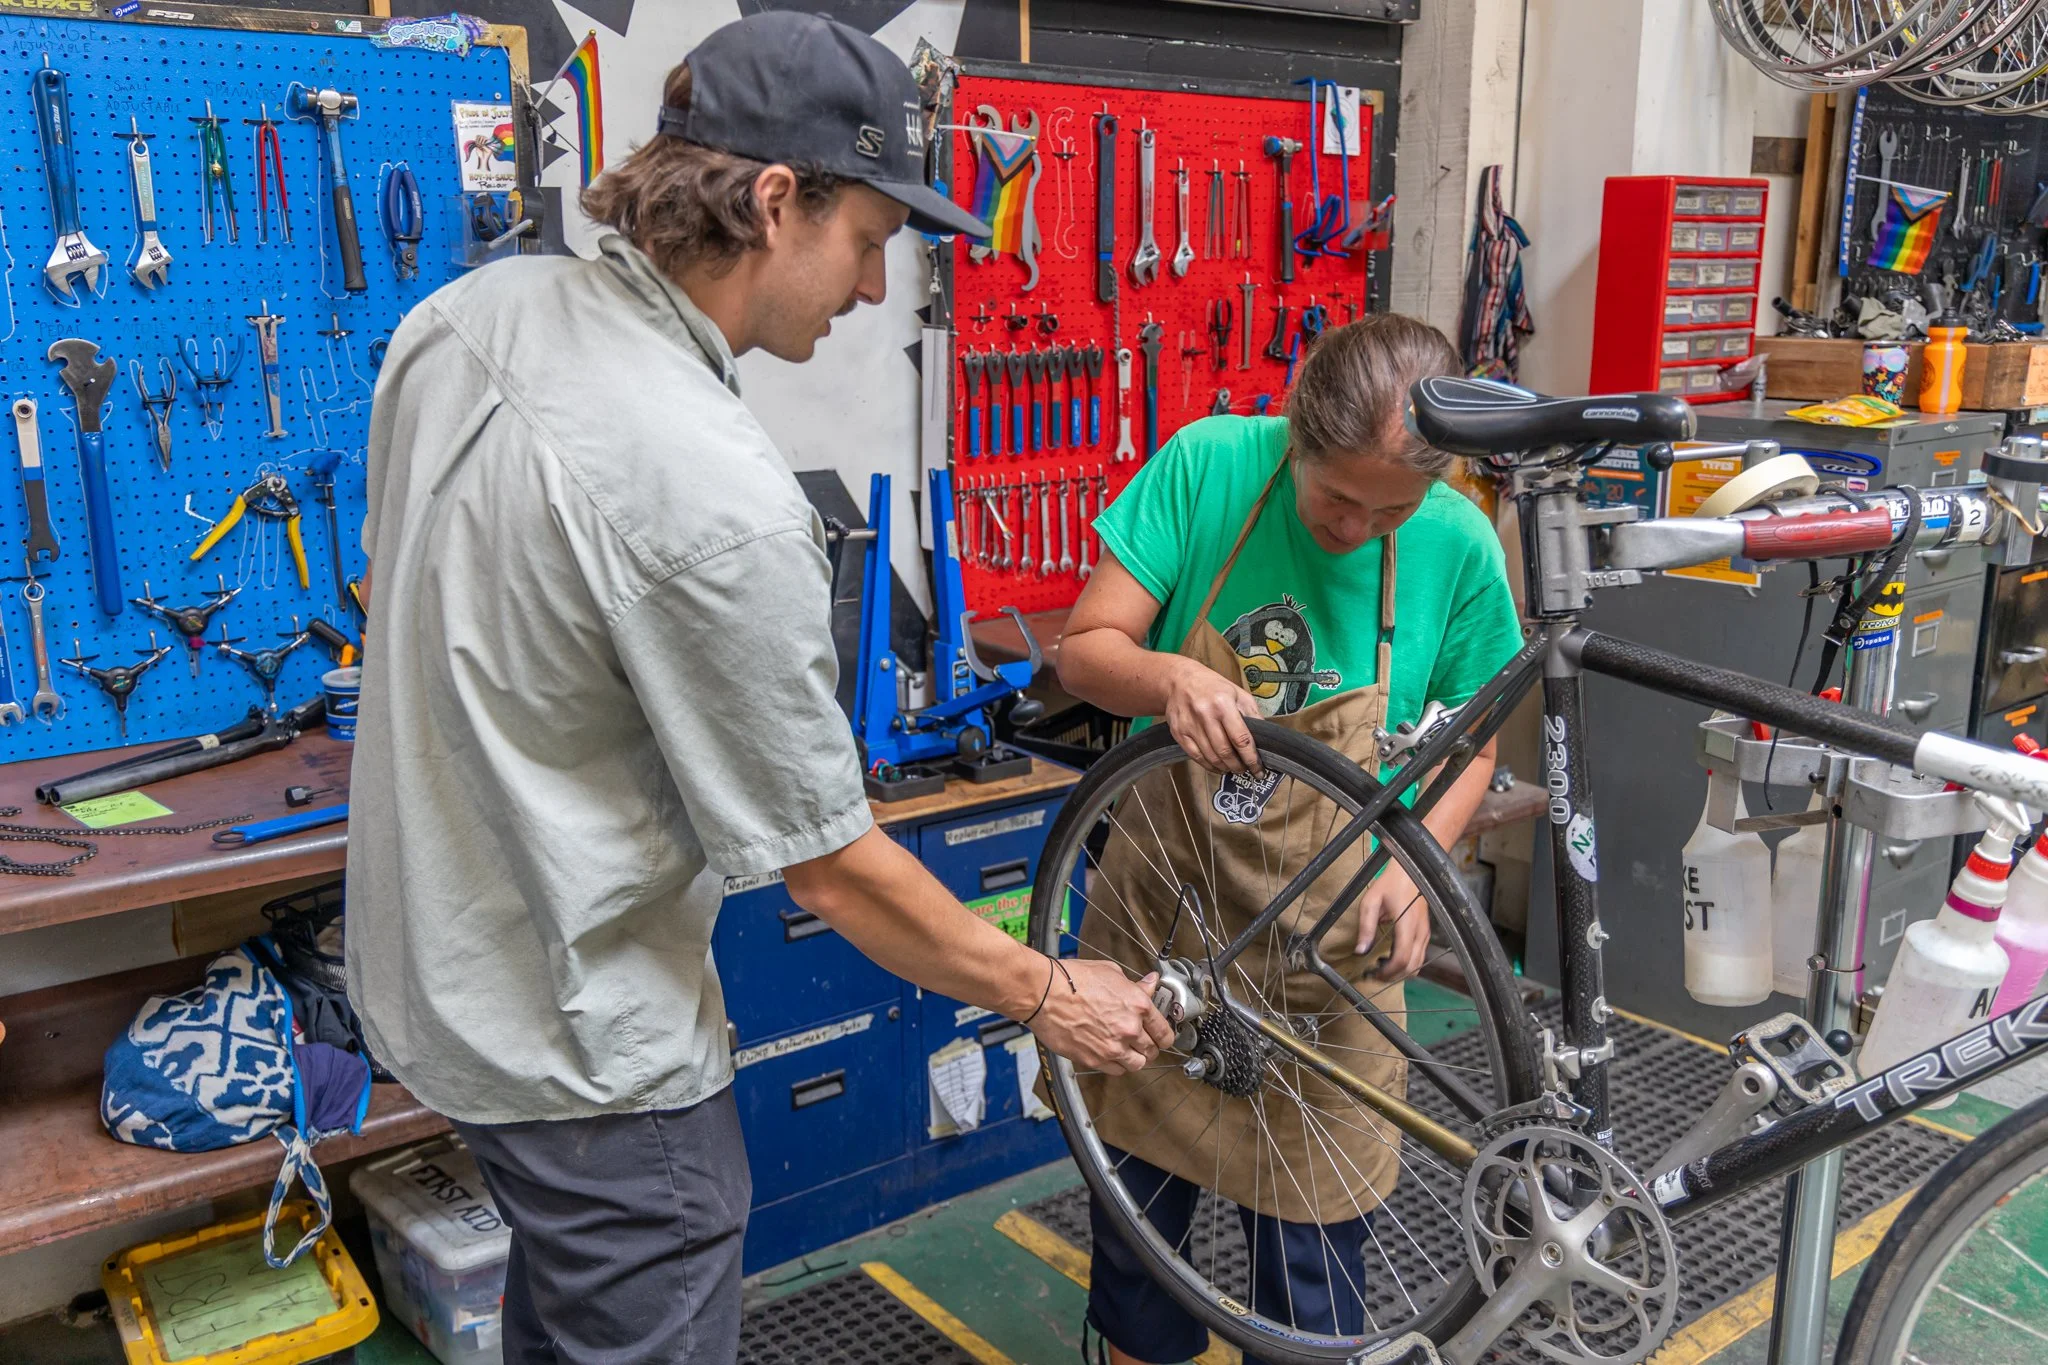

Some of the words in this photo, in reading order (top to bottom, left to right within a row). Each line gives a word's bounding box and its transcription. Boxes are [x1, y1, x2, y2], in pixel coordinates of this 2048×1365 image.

[1585, 408, 1637, 419] cannondale
[1969, 509, 1981, 527] 2
[1865, 634, 1890, 647] spokes
[1544, 714, 1571, 825] 2300
[997, 896, 1018, 910] the
[1834, 992, 2048, 1123] TREK
[409, 1164, 473, 1204] FIRST
[454, 1204, 502, 1232] AID
[154, 1264, 247, 1344] FIRST
